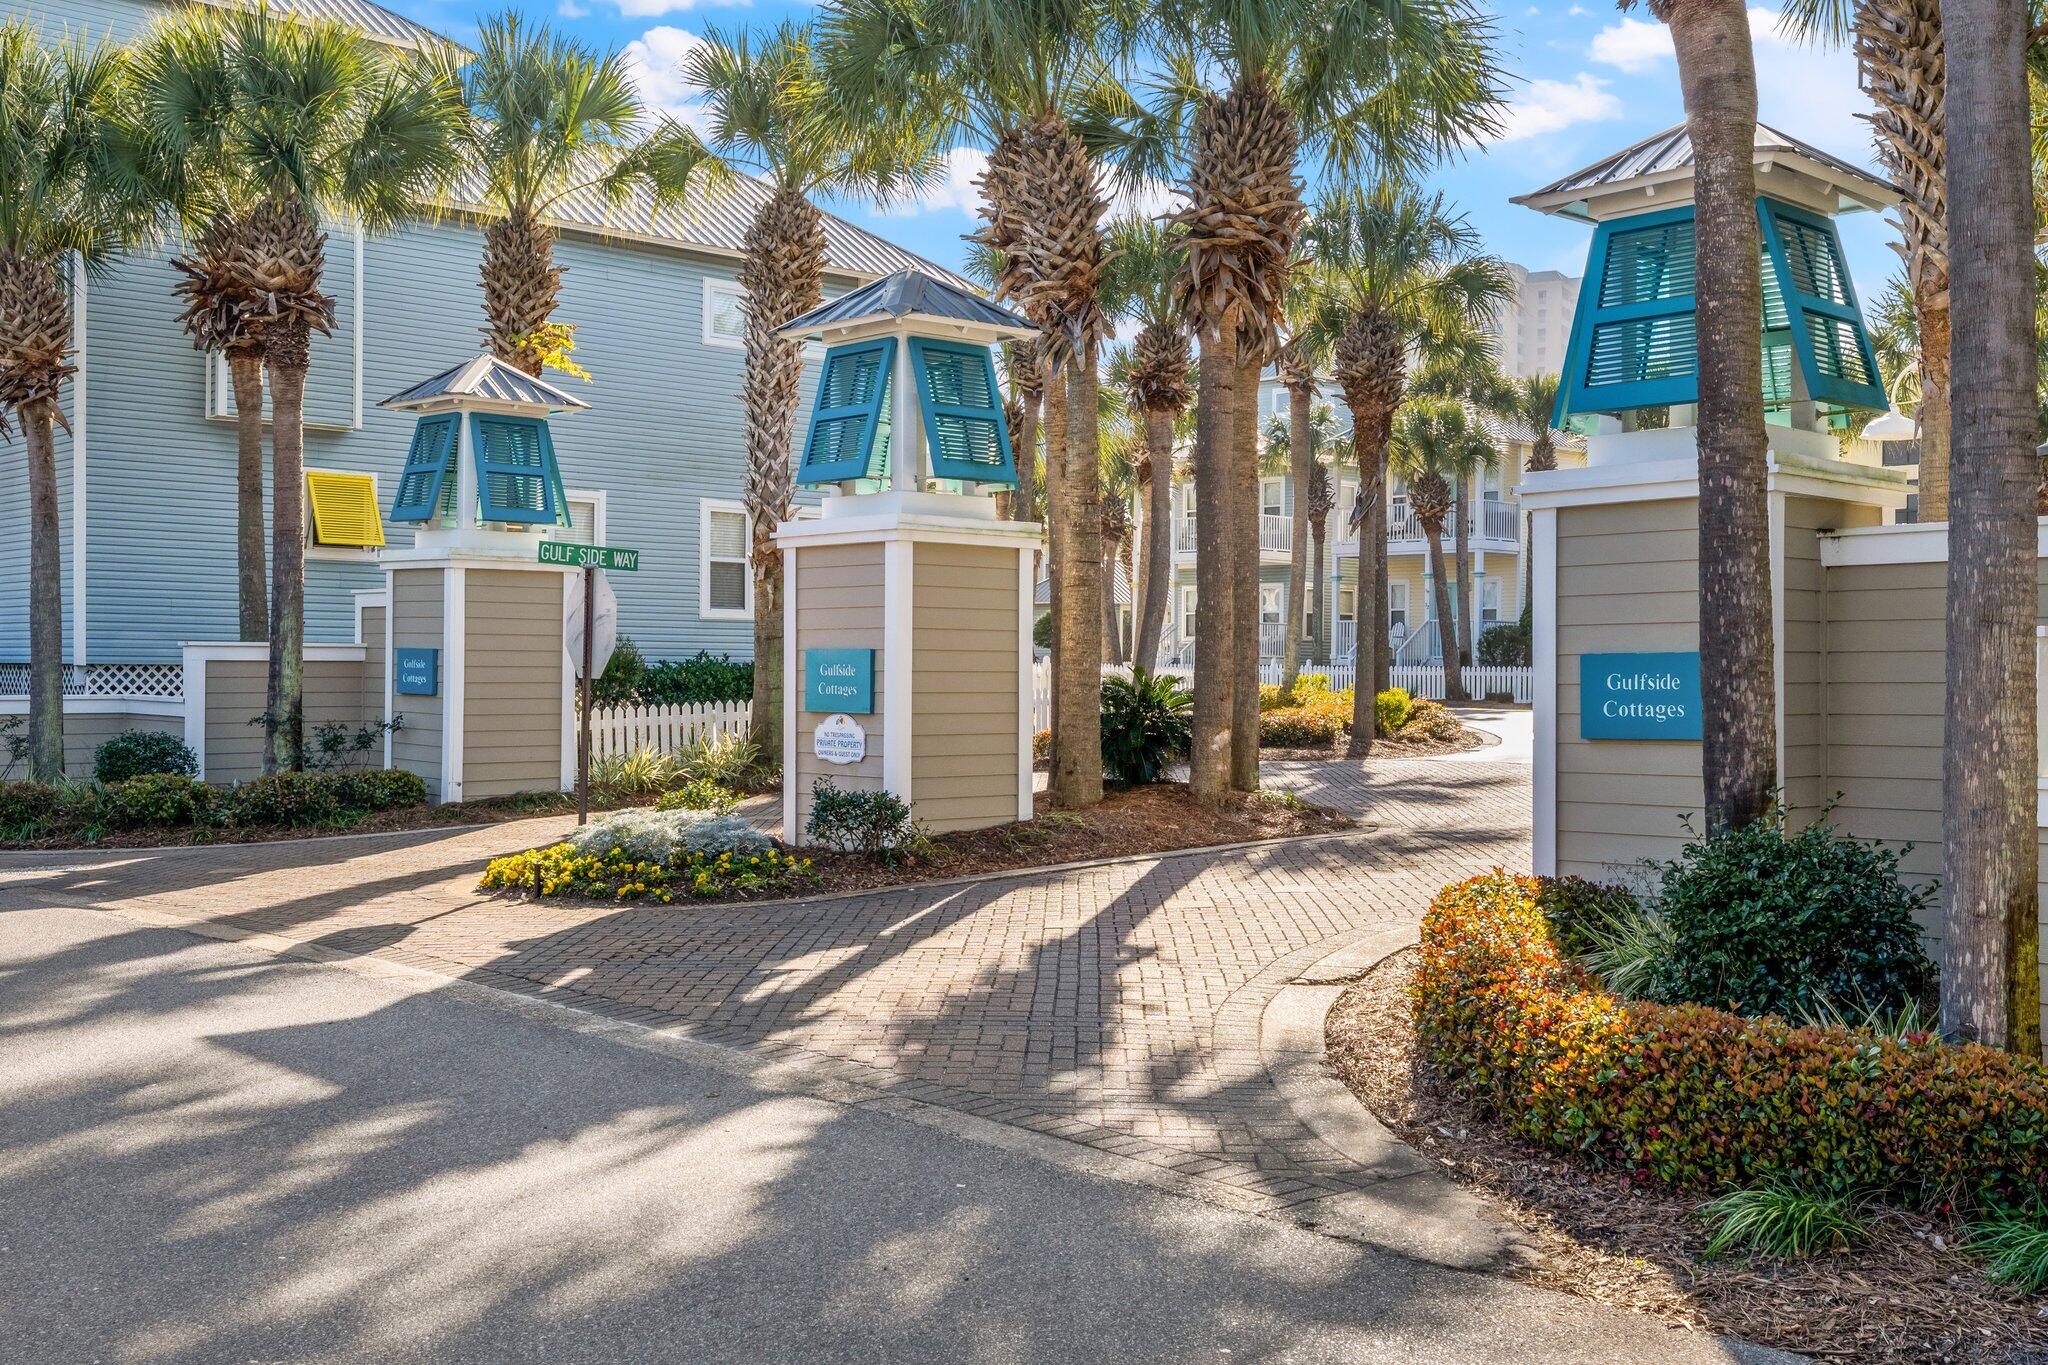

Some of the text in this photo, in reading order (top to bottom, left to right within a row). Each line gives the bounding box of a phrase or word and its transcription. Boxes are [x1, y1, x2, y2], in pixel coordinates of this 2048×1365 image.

[541, 544, 637, 568] GULF SIDE WAY
[403, 658, 426, 669] Gulfside
[819, 663, 856, 677] Gulfside
[402, 673, 427, 685] Cottages
[1606, 673, 1681, 691] Gulfside
[818, 681, 858, 697] Cottages
[1602, 700, 1685, 723] Cottages
[816, 739, 863, 749] PRIVATE PROPERTY
